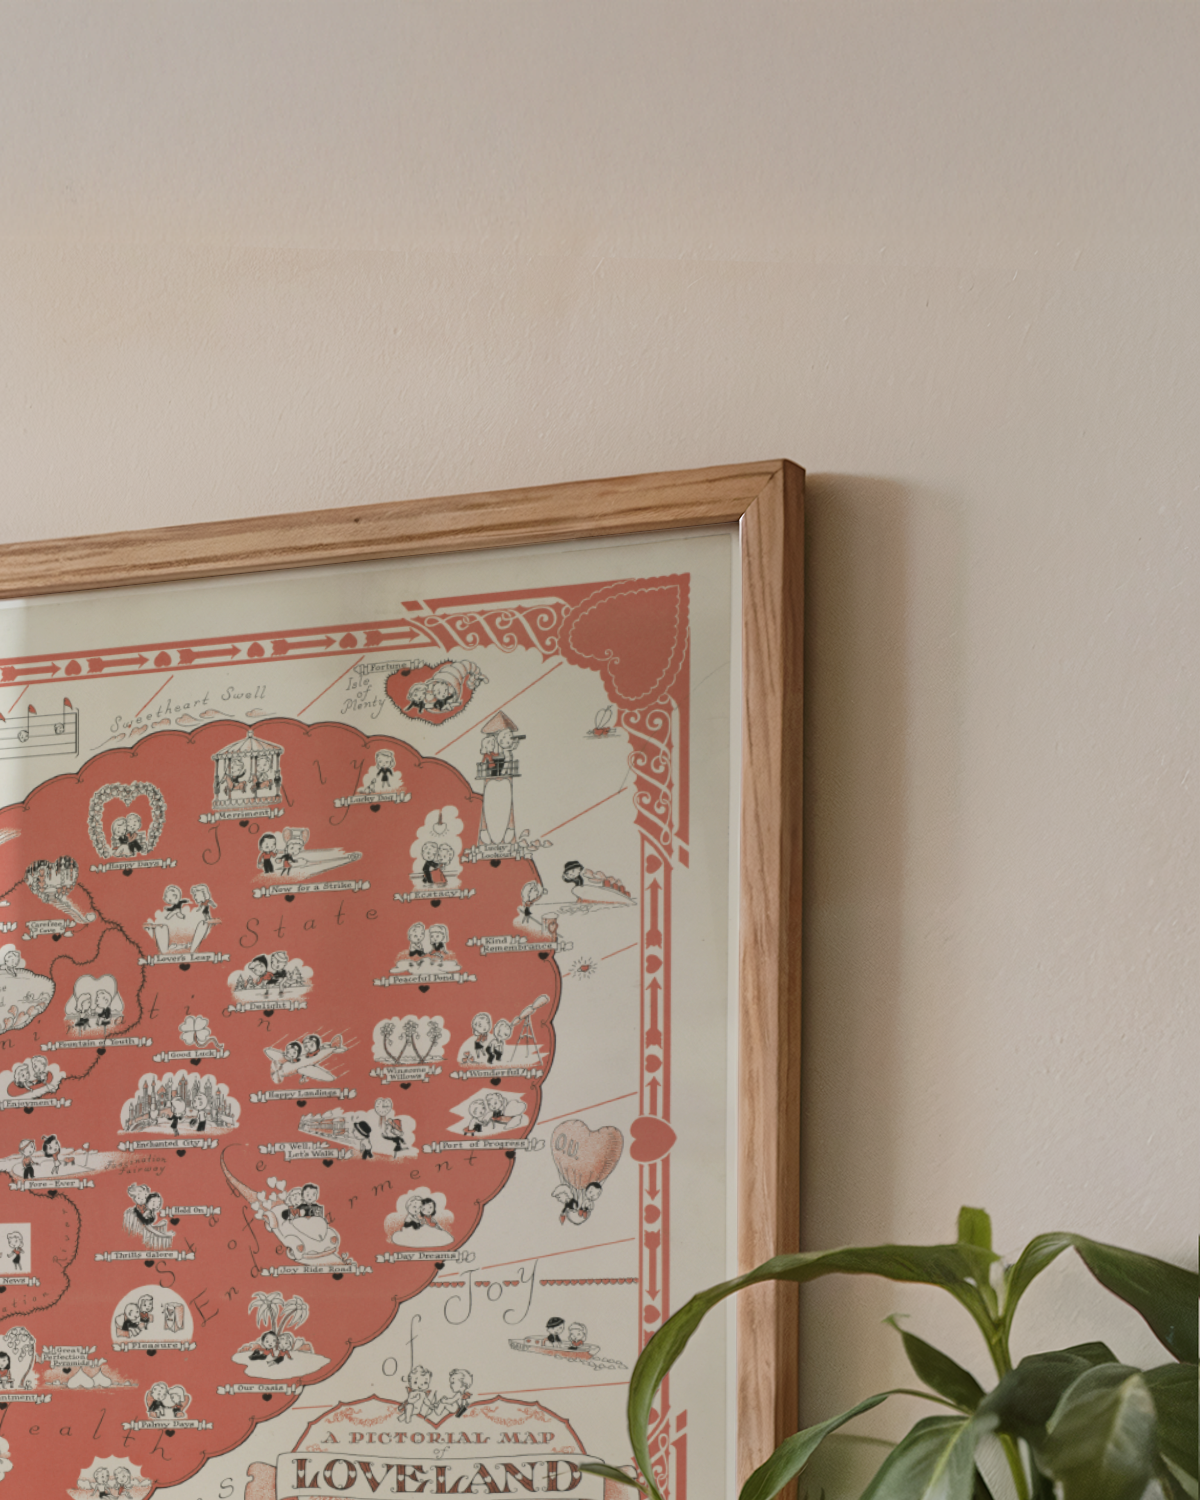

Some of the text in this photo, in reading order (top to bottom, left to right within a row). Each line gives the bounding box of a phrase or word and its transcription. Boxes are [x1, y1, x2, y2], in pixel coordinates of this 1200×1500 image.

[369, 661, 407, 671] Fortune
[346, 675, 371, 692] Isle
[110, 685, 268, 733] Sweetheart Swell
[340, 697, 386, 719] Plenty
[218, 808, 270, 819] Merriment
[108, 858, 160, 871] Happy Days
[270, 884, 294, 894] Now
[297, 883, 311, 892] for
[322, 880, 353, 891] Strike
[484, 936, 508, 946] Kind
[482, 941, 553, 953] Remembrance
[155, 952, 212, 963] Lover's Leap
[392, 973, 432, 984] Peaceful
[249, 1000, 287, 1011] Delight
[267, 1089, 338, 1102] Happy Landings
[5, 1099, 53, 1109] Enjoyment
[441, 1139, 526, 1151] Port of Progress
[113, 1250, 175, 1260] Thrills Galore
[395, 1250, 458, 1261] Day Dreams
[2, 1275, 27, 1285] News
[131, 1341, 179, 1350] Pleasure
[320, 1430, 556, 1445] A PICTORIAL MAP
[432, 1444, 451, 1460] of
[291, 1457, 583, 1495] LOVELAND
